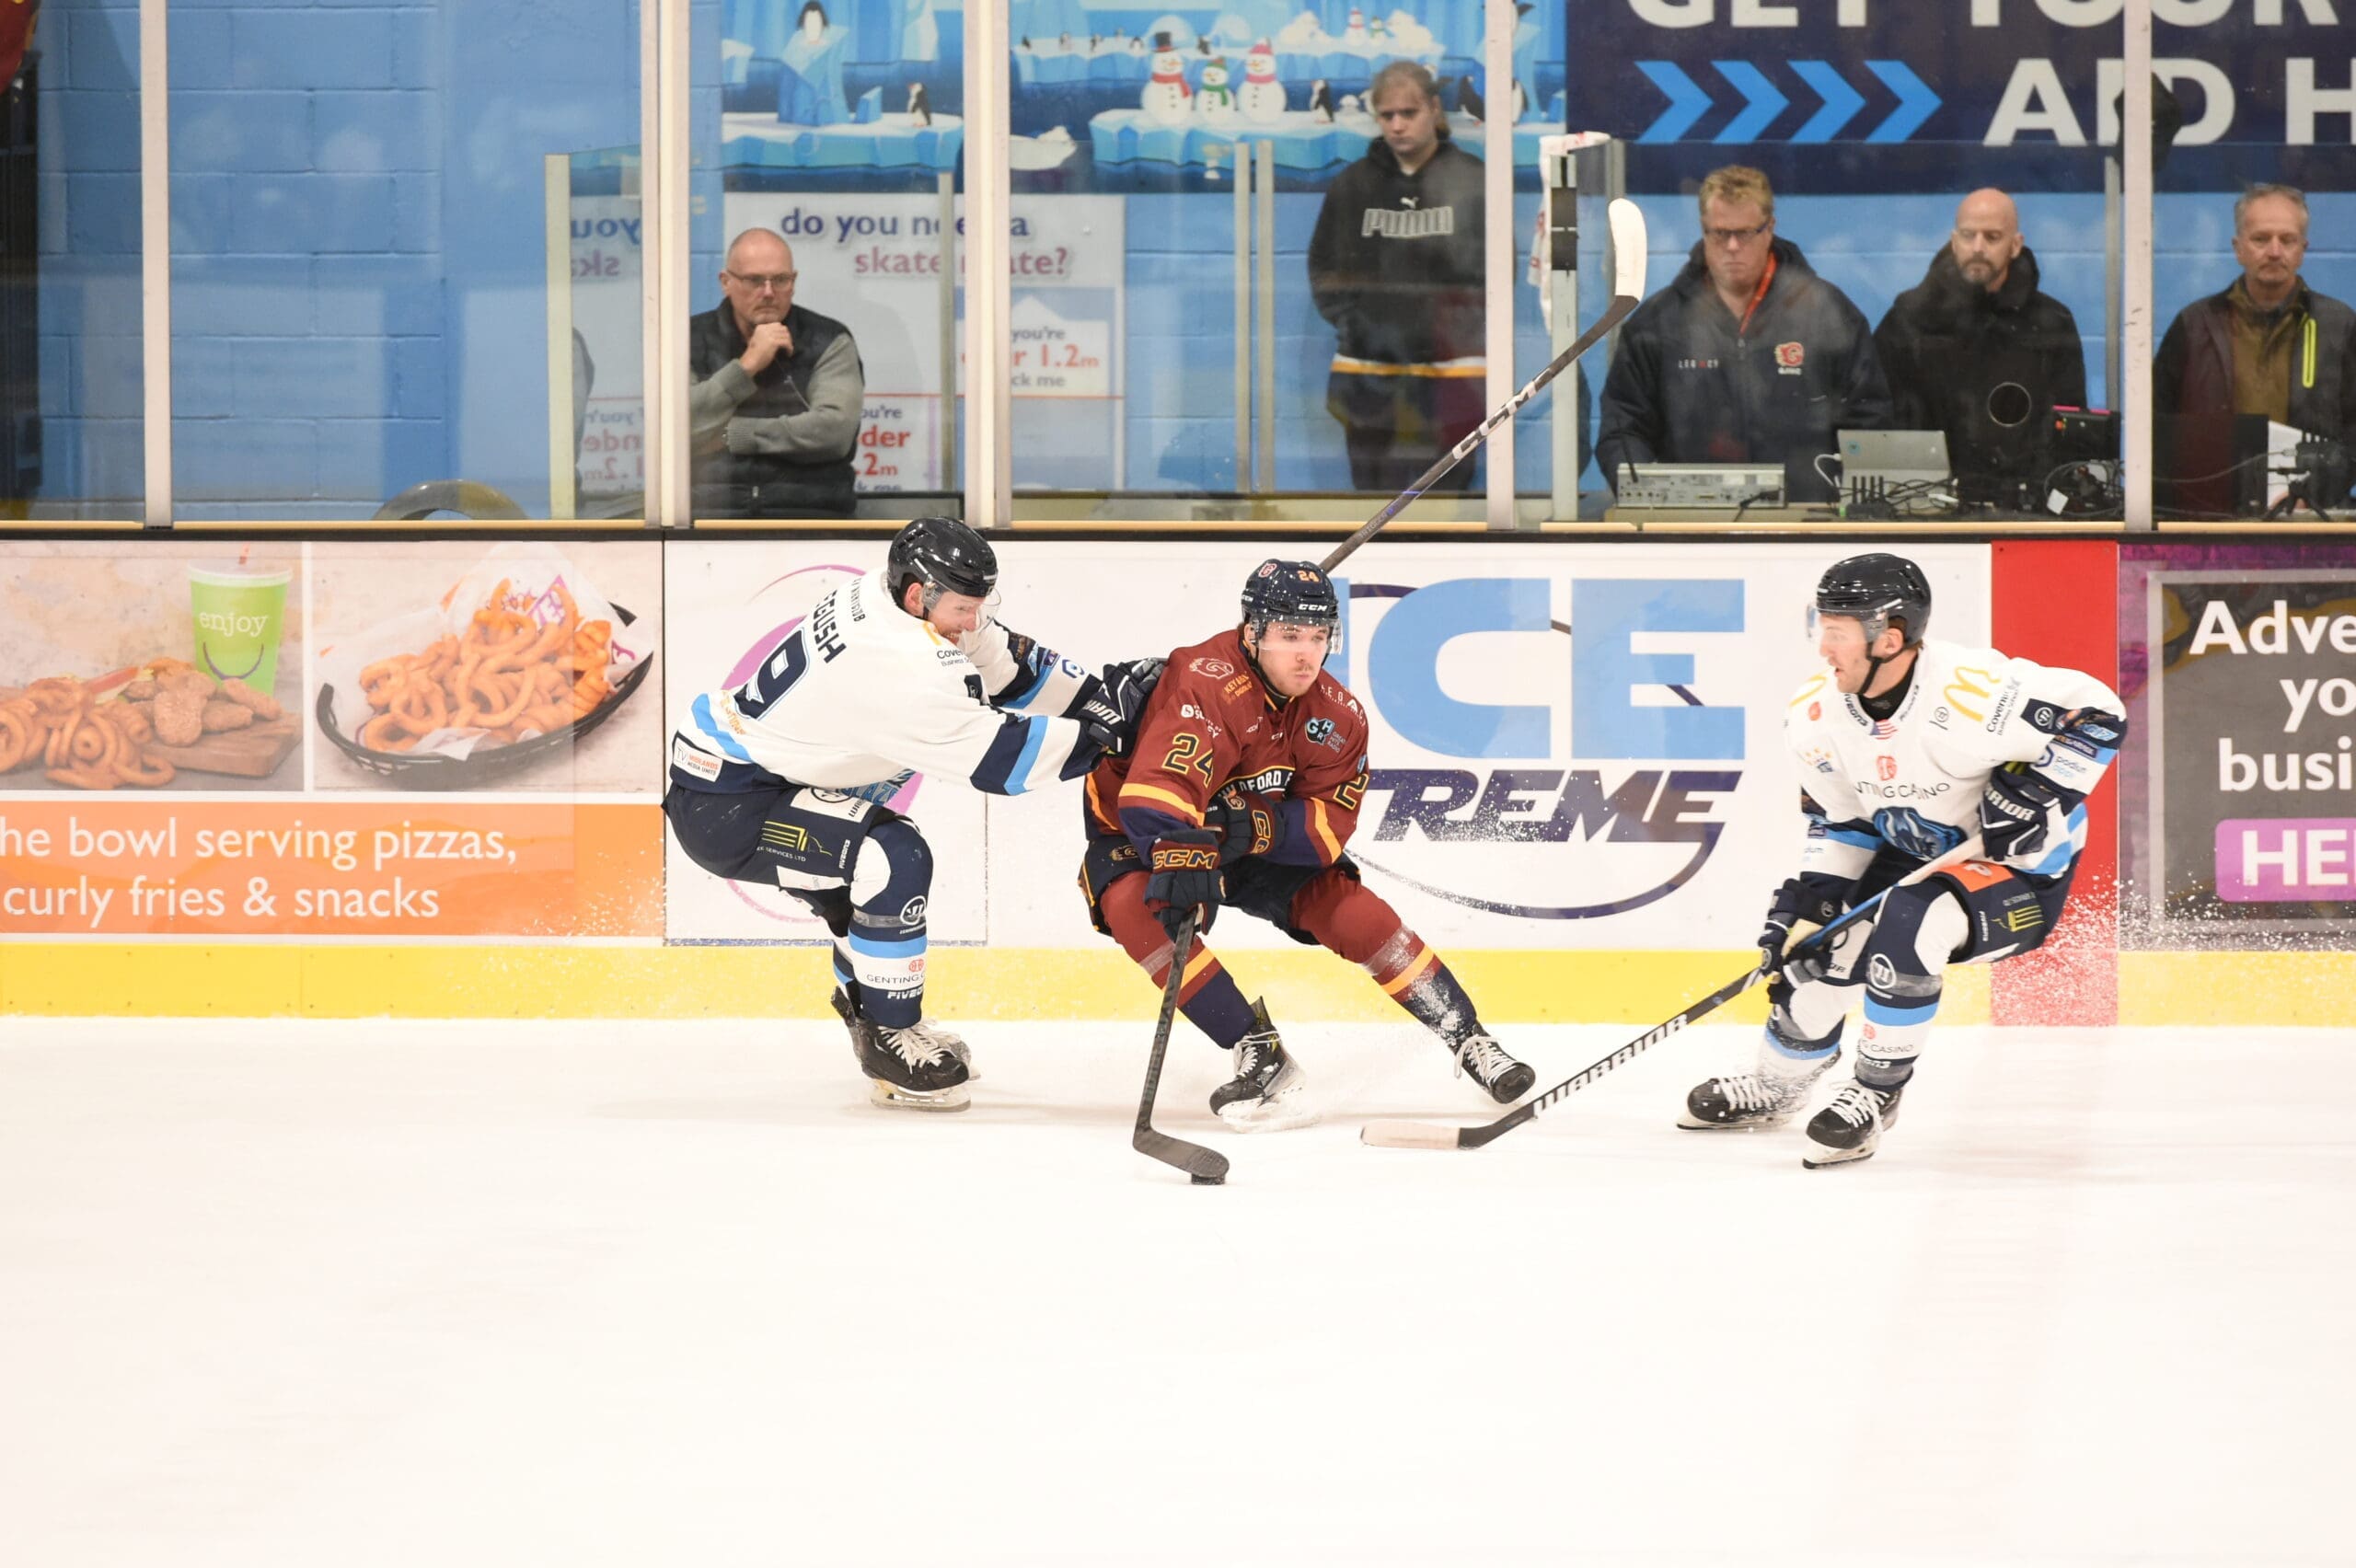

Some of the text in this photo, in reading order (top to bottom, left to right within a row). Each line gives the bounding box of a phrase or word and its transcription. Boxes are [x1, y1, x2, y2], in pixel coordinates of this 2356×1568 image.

[781, 207, 824, 236] do
[836, 214, 898, 243] you
[1010, 214, 1029, 236] a
[1362, 206, 1454, 237] PUMA
[1041, 343, 1099, 367] 1.2m
[857, 424, 911, 447] der
[854, 452, 898, 476] .2m
[1297, 570, 1320, 582] 24
[199, 611, 269, 637] enjoy
[1298, 604, 1327, 612] CCM
[2189, 600, 2356, 655] Adve
[1329, 578, 1745, 759] CE
[2279, 678, 2356, 732] yo
[1162, 732, 1214, 789] 24
[2219, 736, 2353, 791] busi
[1366, 769, 1744, 842] REME
[70, 817, 176, 858] bowl
[196, 822, 357, 870] serving
[375, 822, 516, 870] pizzas,
[1152, 849, 1218, 870] CCM
[2242, 830, 2356, 886] HE
[5, 875, 440, 928] curly fries & snacks
[866, 972, 919, 985] GENTING
[1532, 1013, 1688, 1115] WARRIOR
[1870, 1043, 1914, 1054] CASINO
